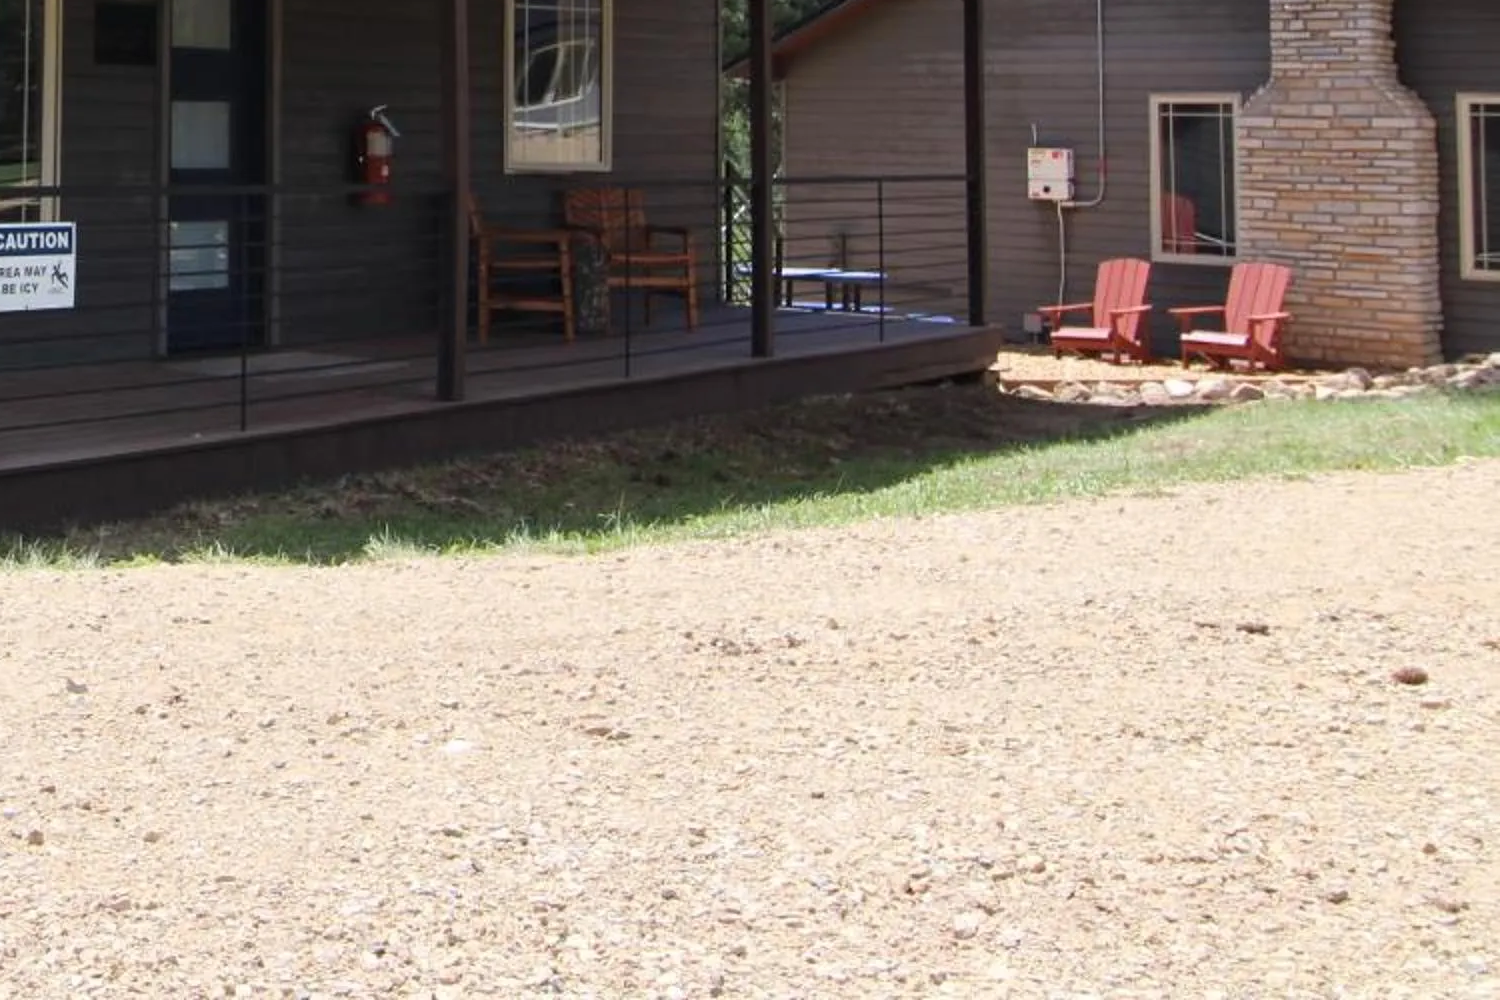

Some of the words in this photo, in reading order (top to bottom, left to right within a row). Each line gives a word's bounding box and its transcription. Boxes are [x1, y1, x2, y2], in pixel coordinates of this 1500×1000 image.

[24, 265, 47, 277] MAY
[1, 283, 16, 294] BE
[20, 283, 39, 294] ICY
